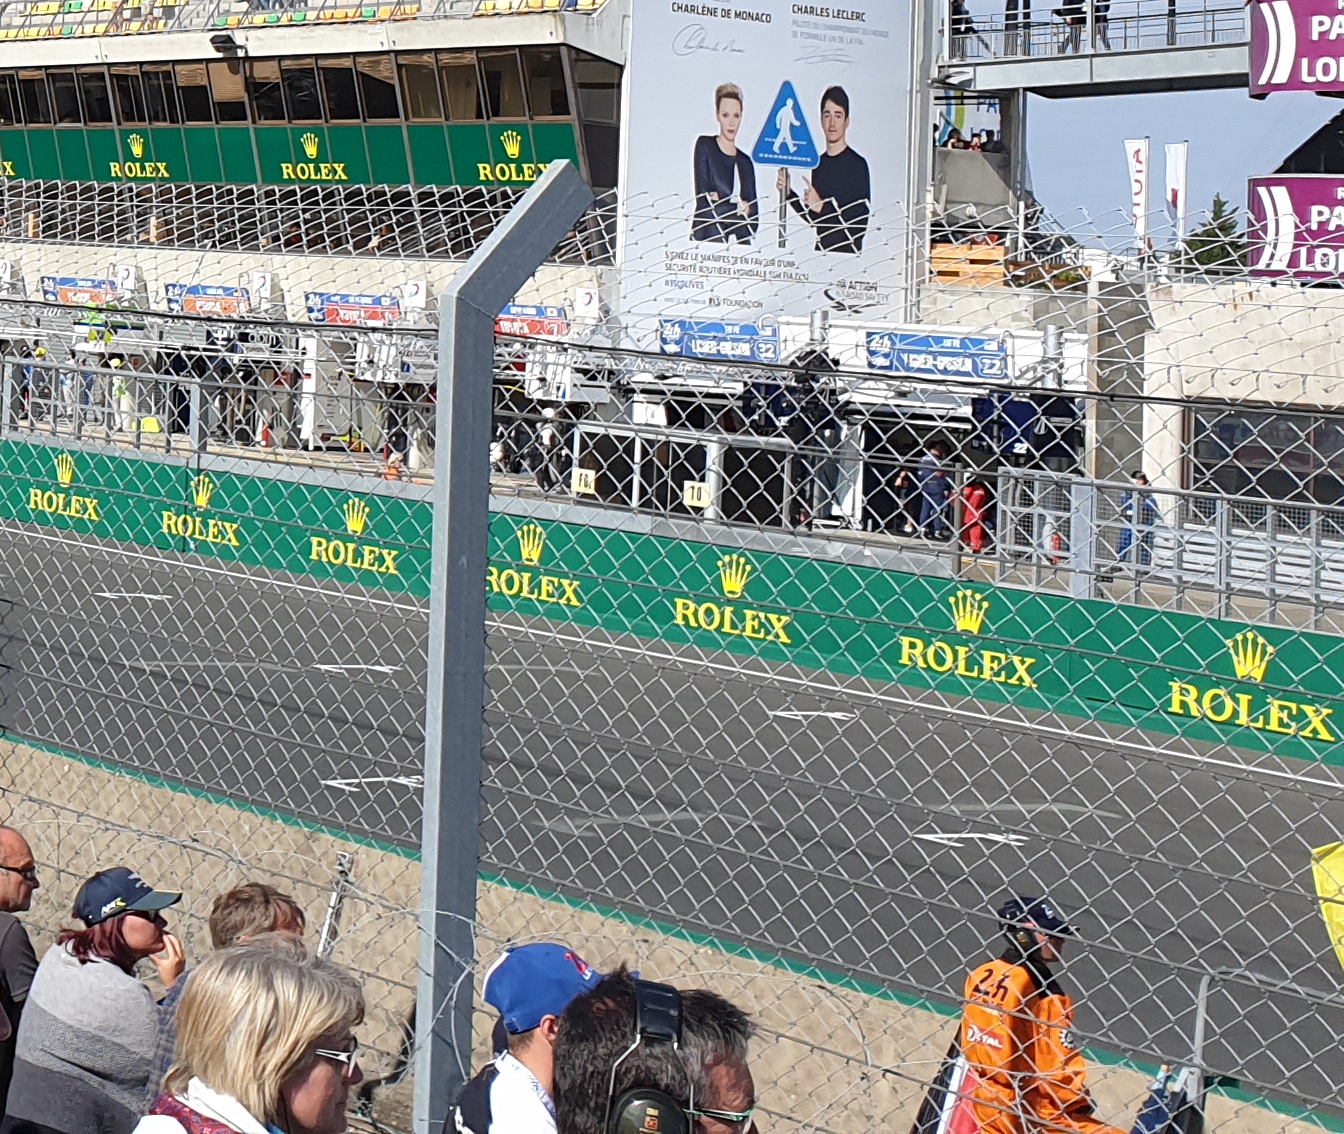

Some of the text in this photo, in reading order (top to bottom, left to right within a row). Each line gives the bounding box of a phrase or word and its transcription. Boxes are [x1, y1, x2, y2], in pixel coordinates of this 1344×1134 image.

[671, 1, 772, 24] CHARLÈNE DE MONACO
[791, 3, 866, 22] CHARLES LECLERC
[1312, 15, 1344, 41] PA
[109, 161, 170, 178] ROLEX
[280, 163, 348, 181] ROLEX
[1310, 205, 1344, 231] PA
[29, 488, 100, 521] ROLEX
[161, 511, 240, 546] ROLEX
[310, 537, 399, 575] ROLEX
[674, 597, 792, 645] ROLEX
[899, 635, 1038, 689] ROLEX
[1167, 681, 1336, 742] ROLEX
